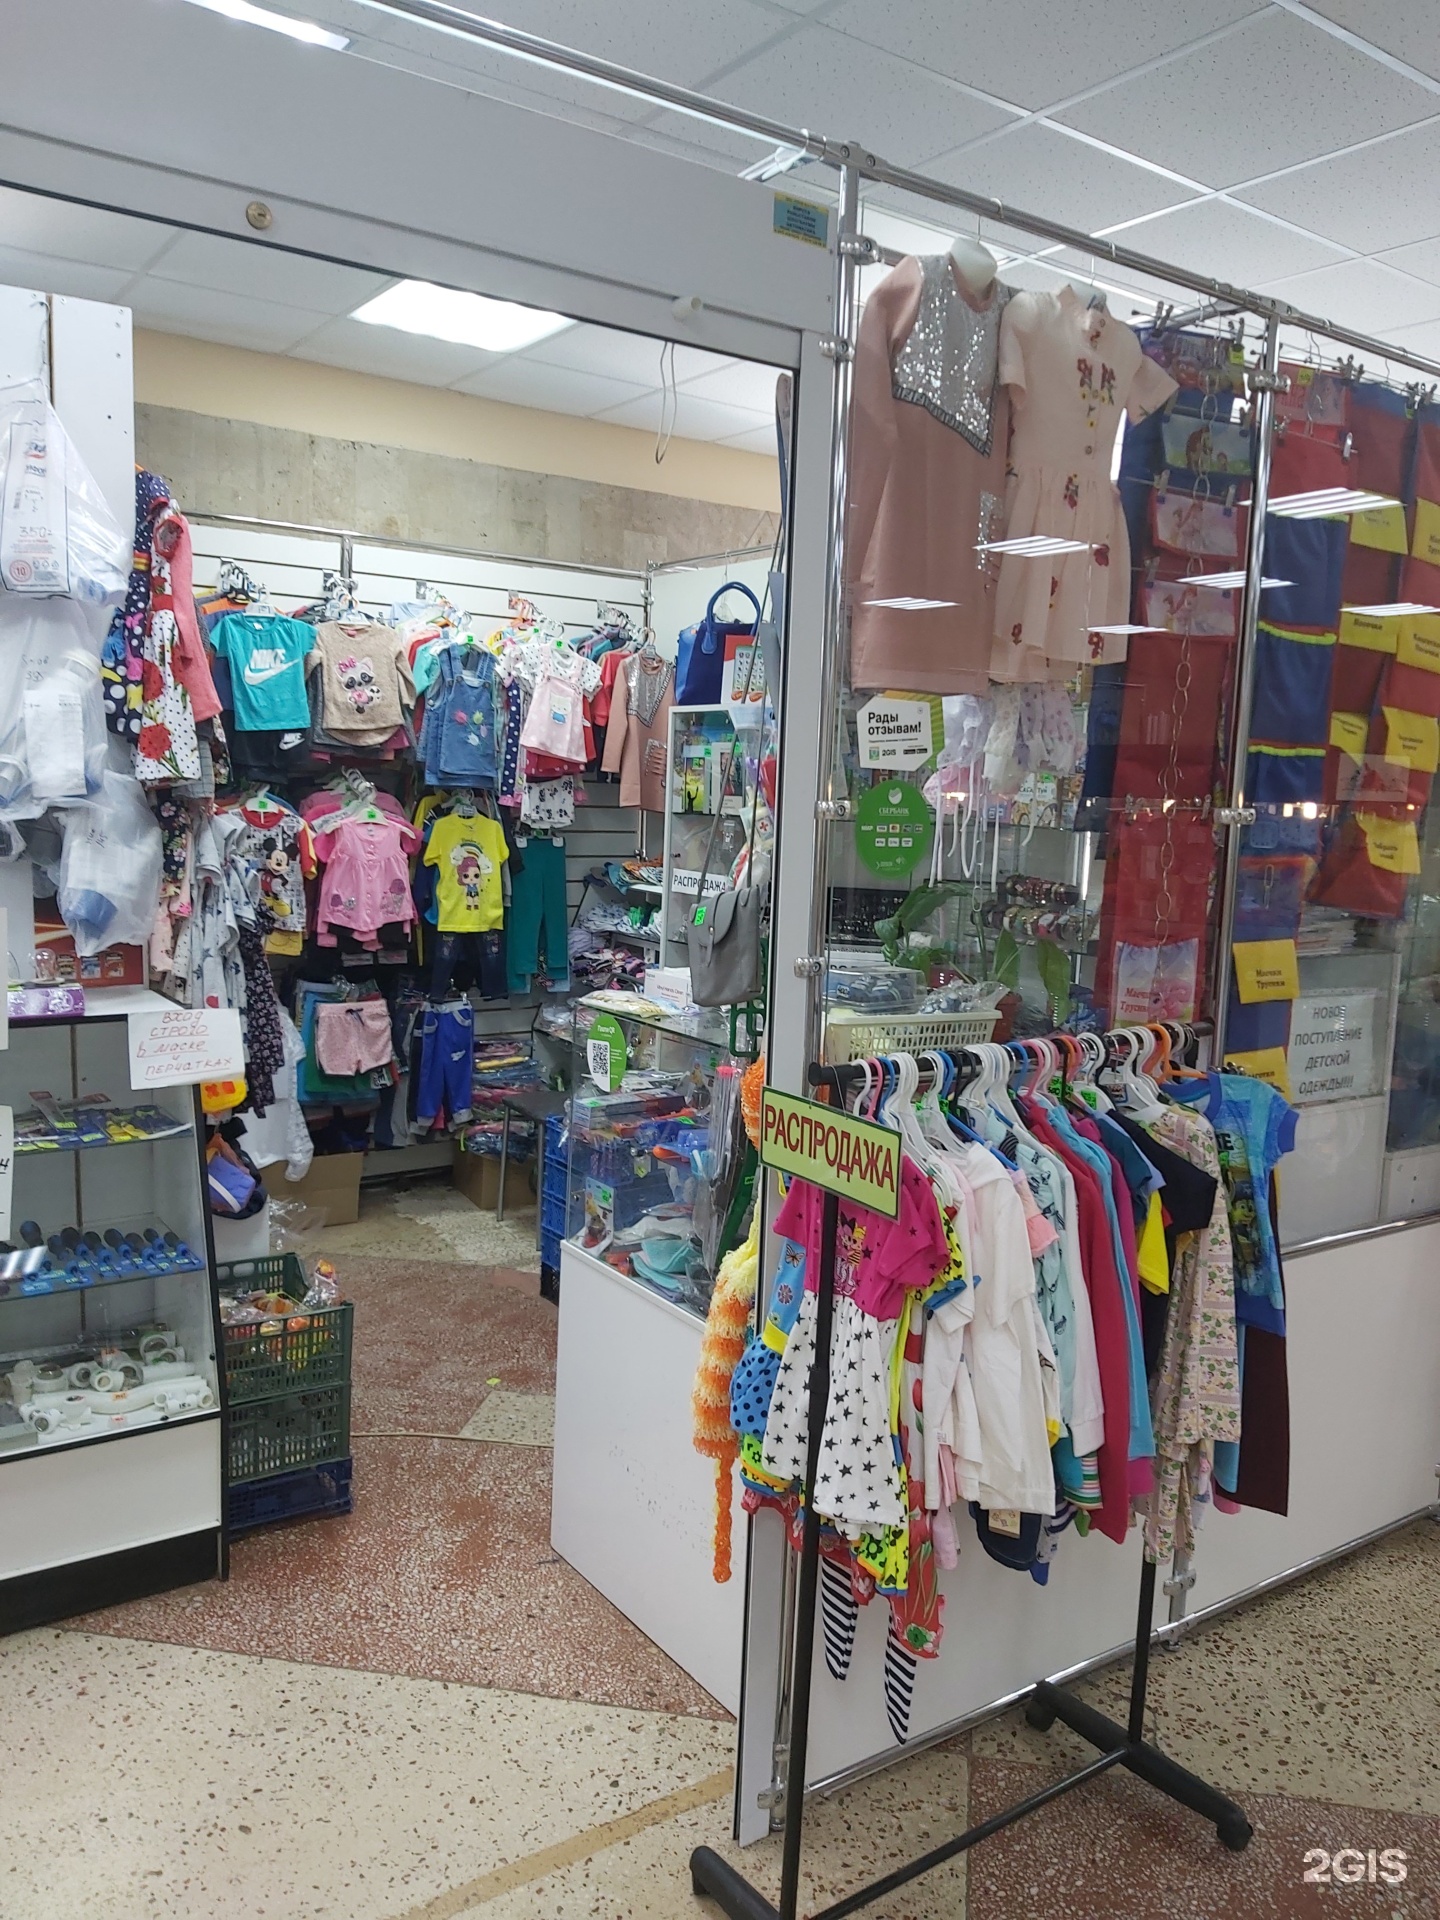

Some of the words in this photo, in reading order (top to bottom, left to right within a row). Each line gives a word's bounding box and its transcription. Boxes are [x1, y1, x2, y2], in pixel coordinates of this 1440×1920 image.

[250, 648, 286, 669] NIKE
[868, 712, 899, 724] Рады
[868, 721, 922, 735] отзывам!
[1305, 1051, 1350, 1070] ДЕТСКОЙ
[1299, 1075, 1354, 1095] ОДЕЖДЫ!!!
[764, 1103, 895, 1193] РАСПРОДАЖА
